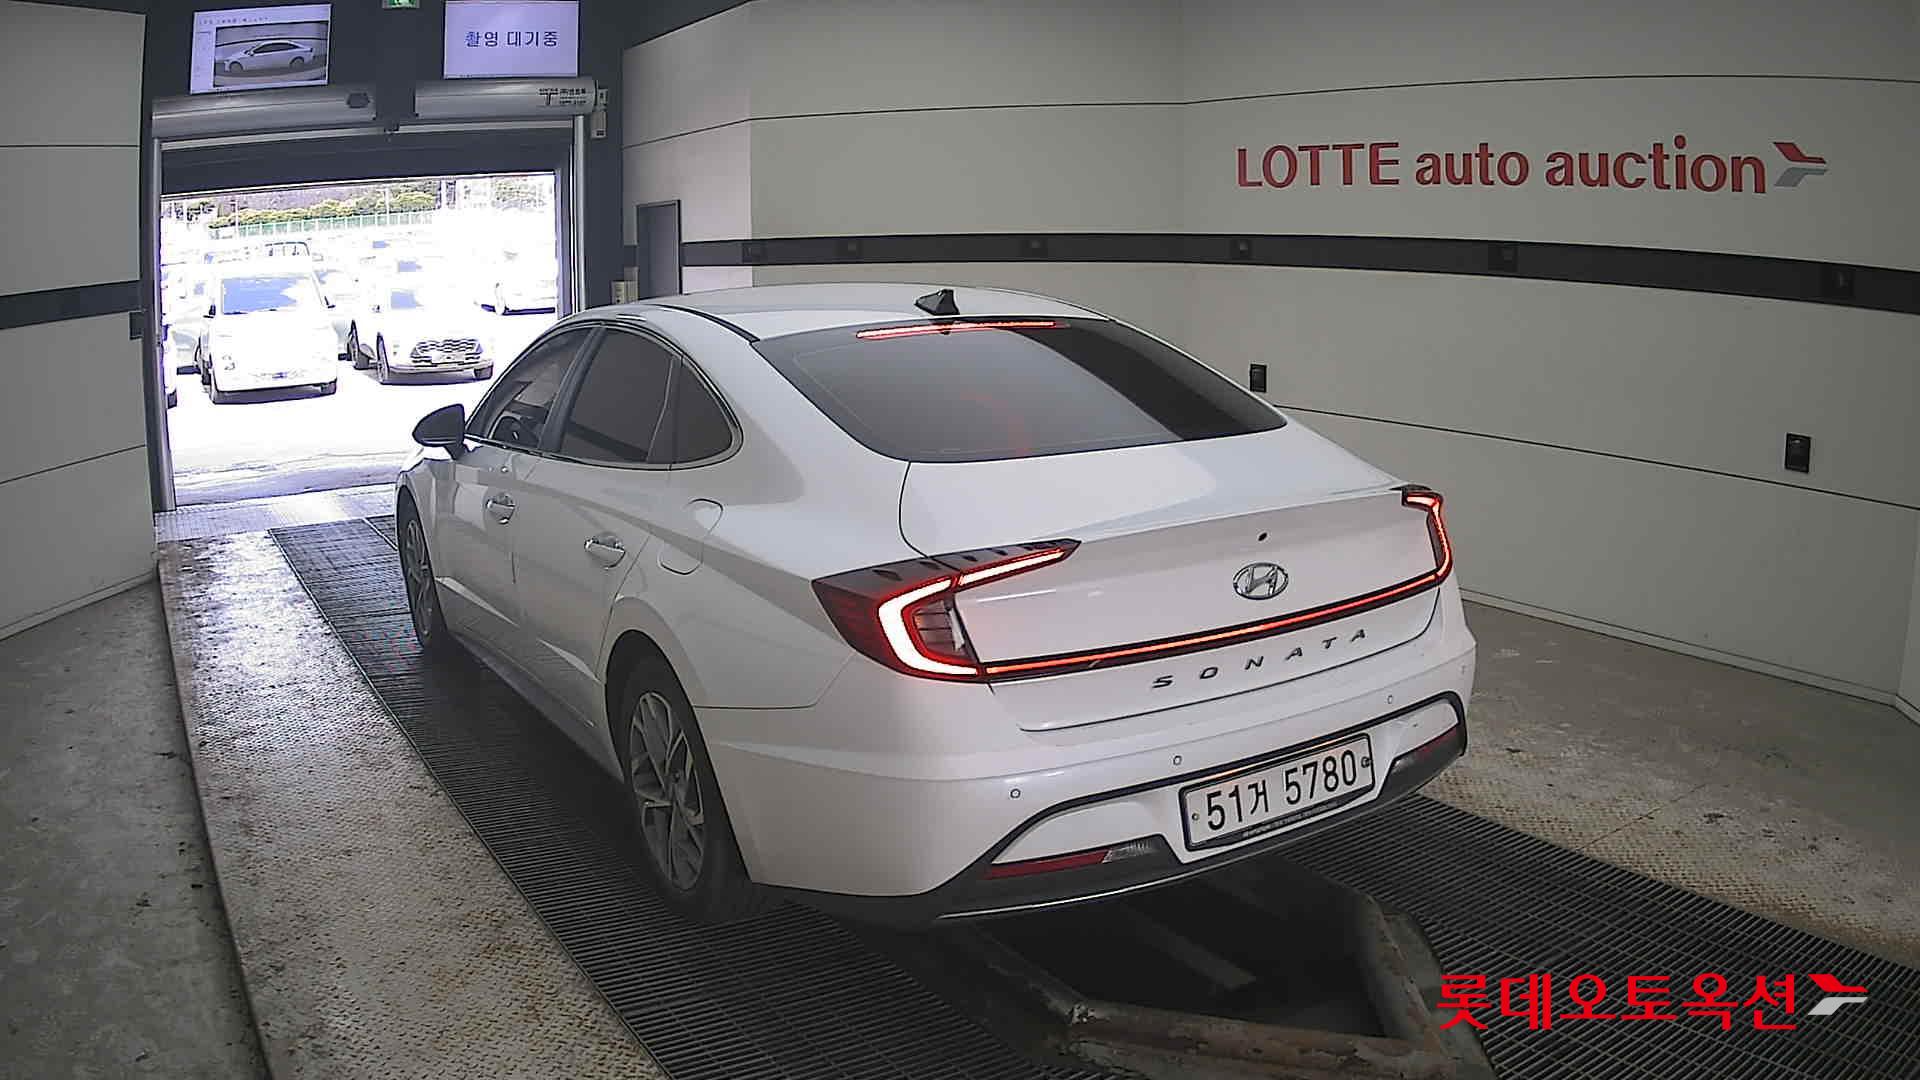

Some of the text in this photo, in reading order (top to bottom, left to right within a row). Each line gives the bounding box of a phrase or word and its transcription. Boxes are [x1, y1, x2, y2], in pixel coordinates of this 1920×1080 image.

[506, 31, 558, 47] 대기중
[1237, 135, 1766, 194] LOTTE auto auction
[1152, 629, 1366, 689] SONATA
[1206, 779, 1269, 831] 51거
[1283, 750, 1357, 805] 5780
